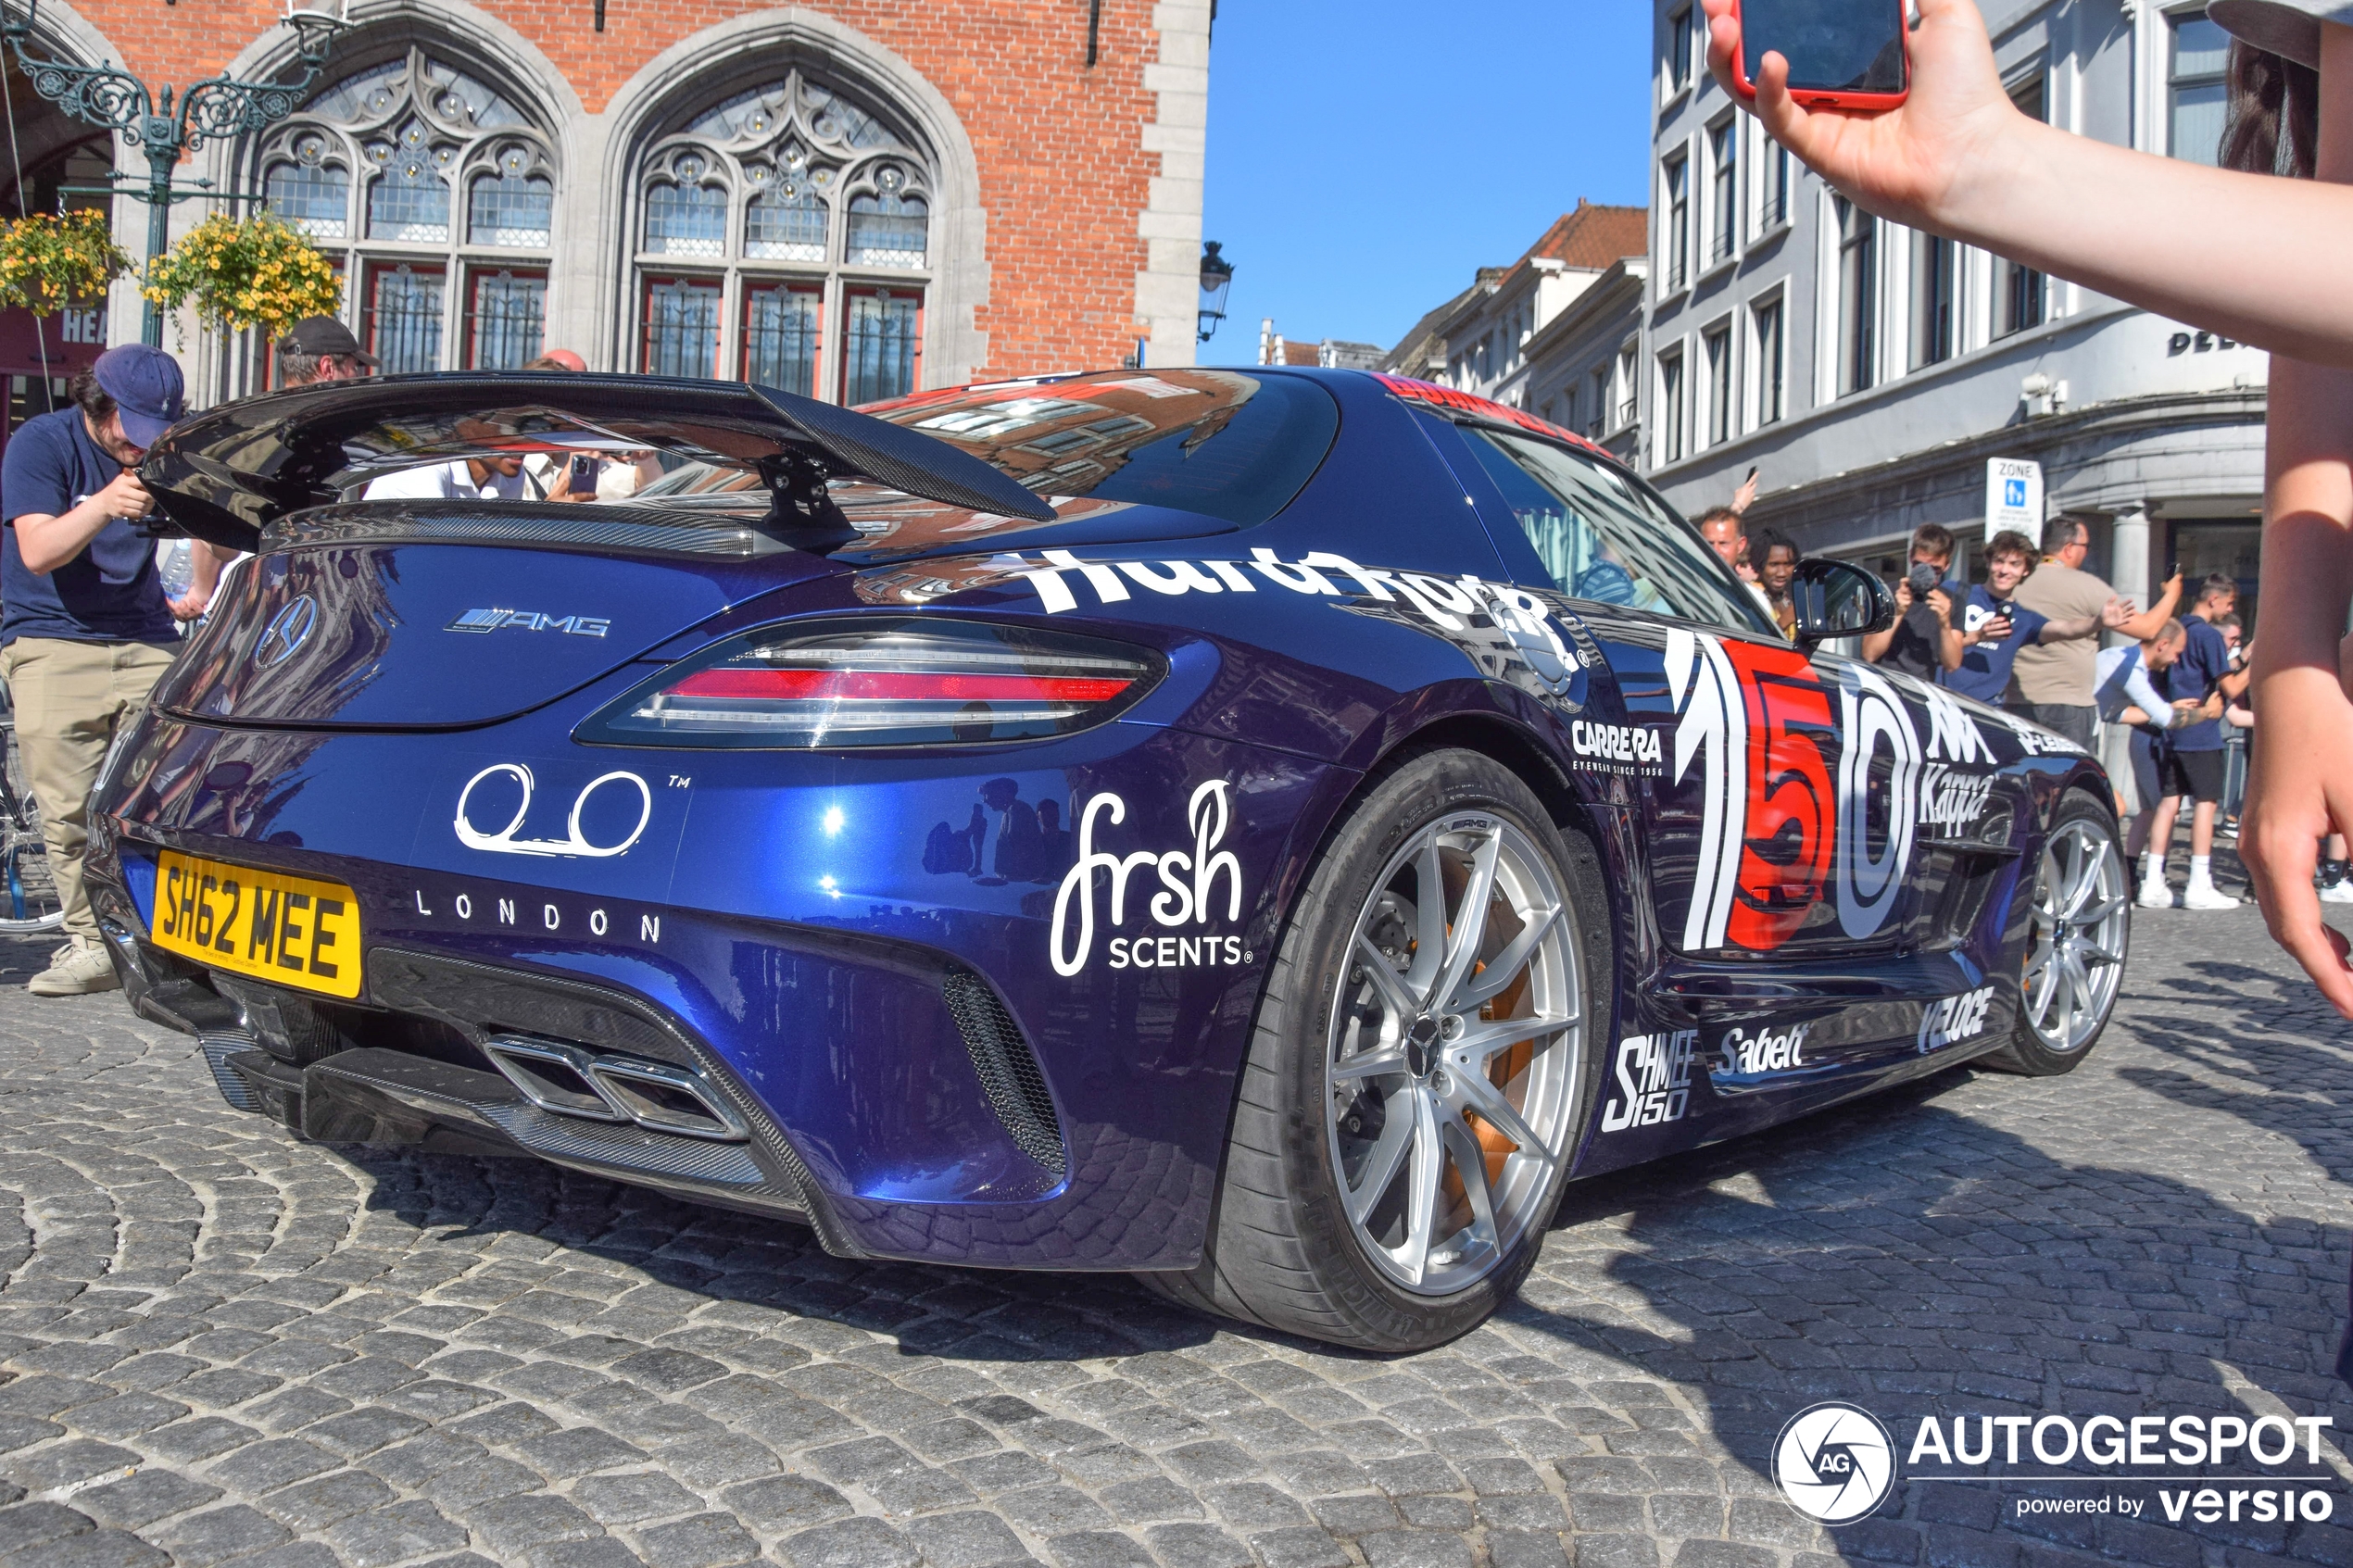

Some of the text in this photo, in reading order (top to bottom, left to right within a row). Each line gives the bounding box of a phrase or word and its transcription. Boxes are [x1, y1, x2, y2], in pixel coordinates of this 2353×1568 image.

[1998, 463, 2033, 479] ZONE
[499, 610, 611, 637] AMG
[1571, 720, 1663, 762] CARRERA
[1572, 761, 1663, 776] EYEWEAR SINCE 1956
[1663, 626, 1922, 951] 150
[1463, 820, 1488, 829] AMG
[1919, 762, 1995, 838] Kappa
[1050, 780, 1241, 977] frsh
[163, 865, 346, 980] SH62 MEE
[416, 889, 661, 944] LONDON
[1108, 935, 1242, 969] SCENTS
[1917, 985, 1994, 1054] VELOCE
[1716, 1024, 1810, 1076] Sabelt
[1601, 1029, 1698, 1133] SHMEE
[1631, 1088, 1689, 1127] 150
